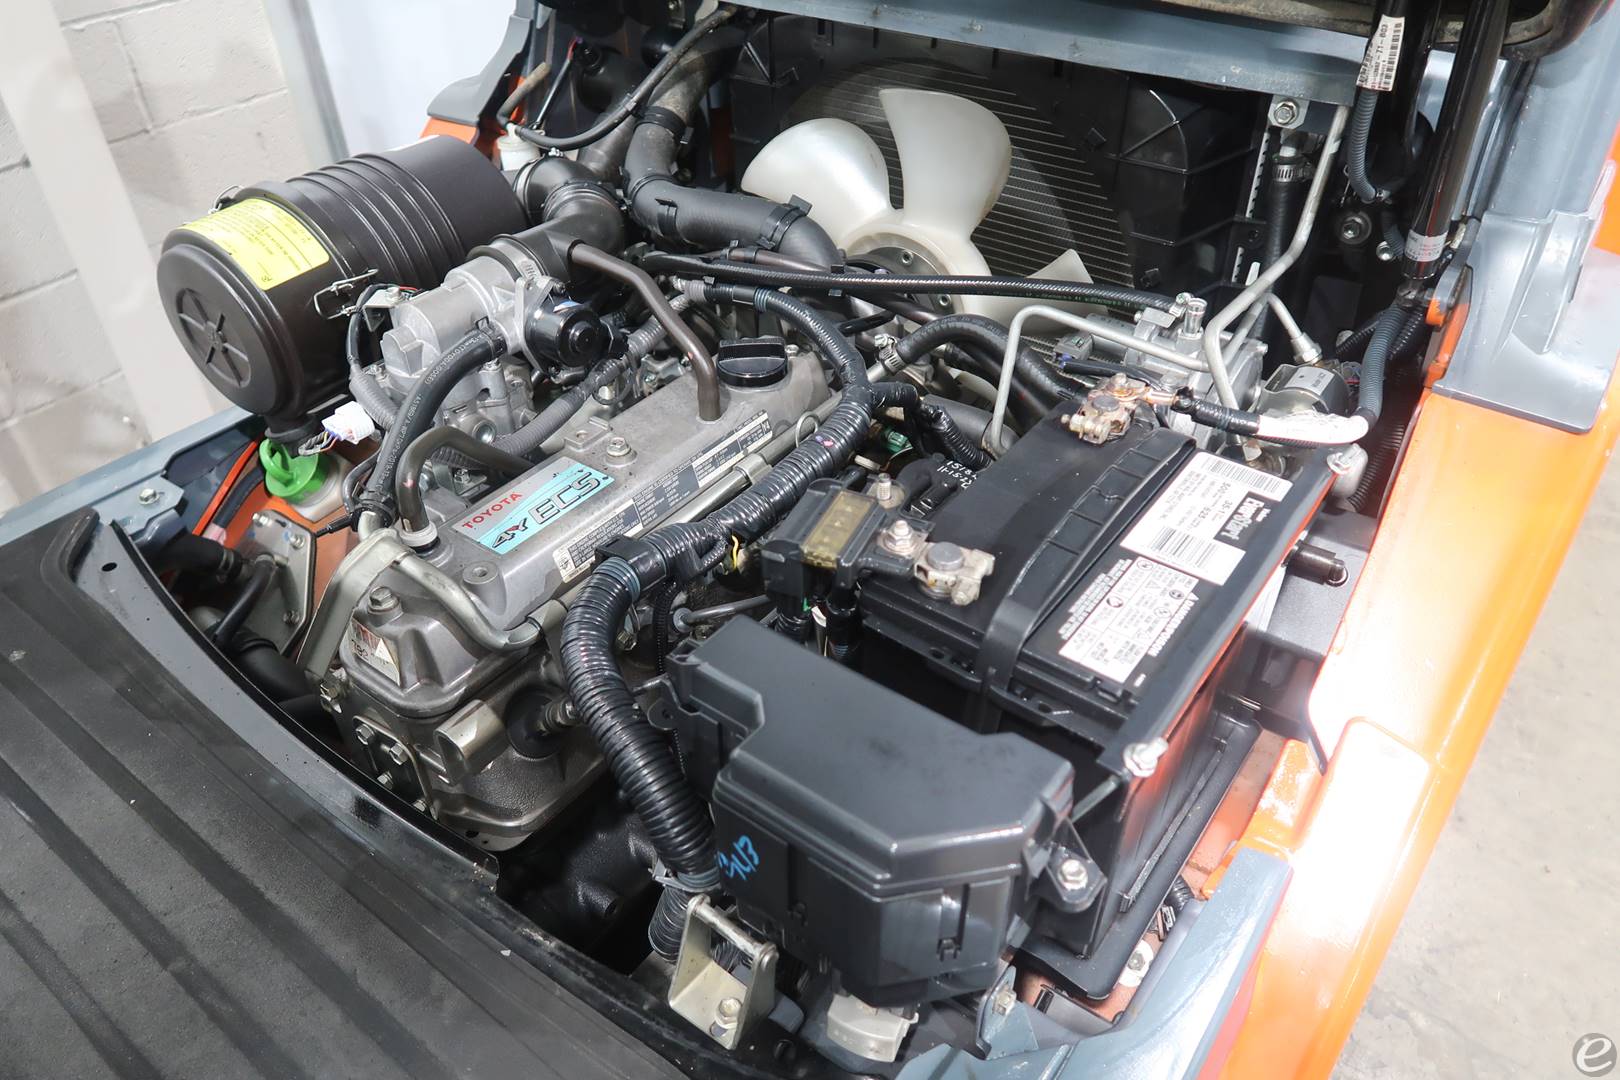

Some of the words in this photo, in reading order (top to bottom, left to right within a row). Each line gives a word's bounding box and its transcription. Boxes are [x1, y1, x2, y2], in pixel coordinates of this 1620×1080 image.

[461, 491, 523, 529] TOYOTA
[491, 517, 529, 548] 4Y
[528, 471, 601, 525] ECS
